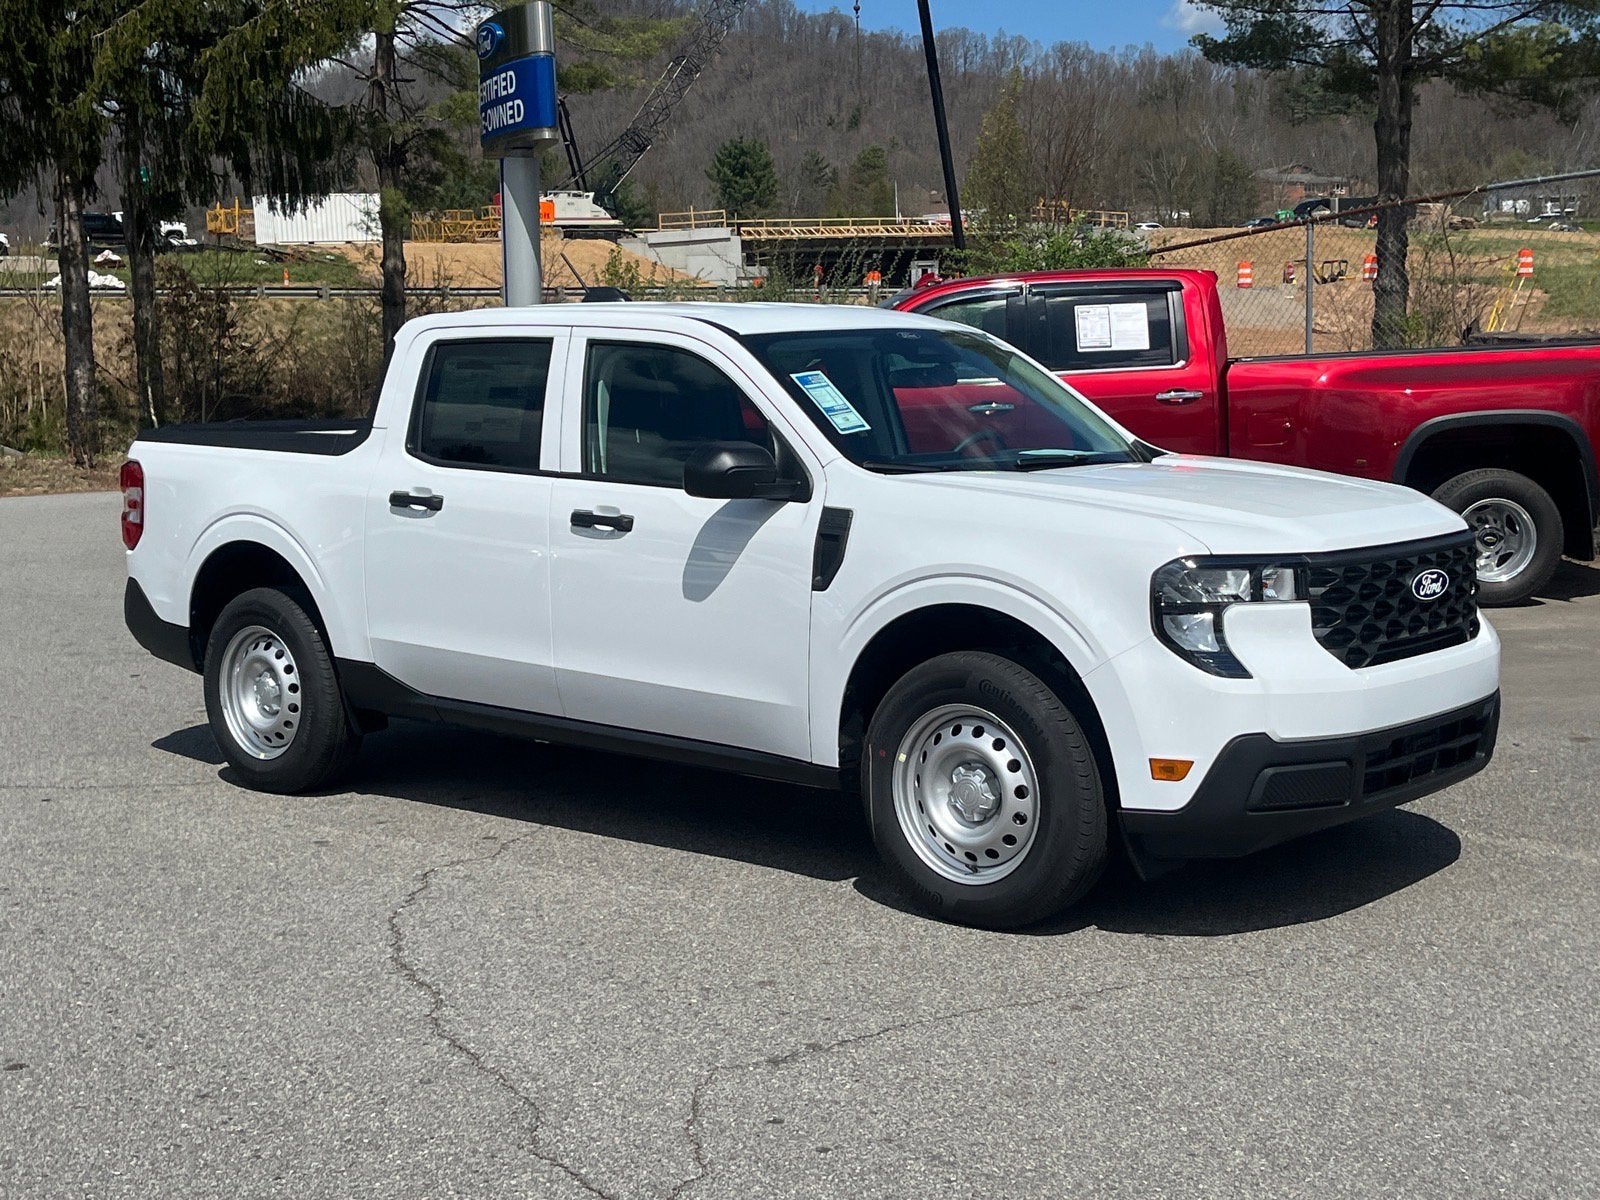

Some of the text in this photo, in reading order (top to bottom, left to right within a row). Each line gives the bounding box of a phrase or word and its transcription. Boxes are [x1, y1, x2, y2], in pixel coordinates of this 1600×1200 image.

[480, 70, 516, 106] ERTIFIED
[481, 99, 525, 135] E-OWNED
[1419, 573, 1443, 596] Ford
